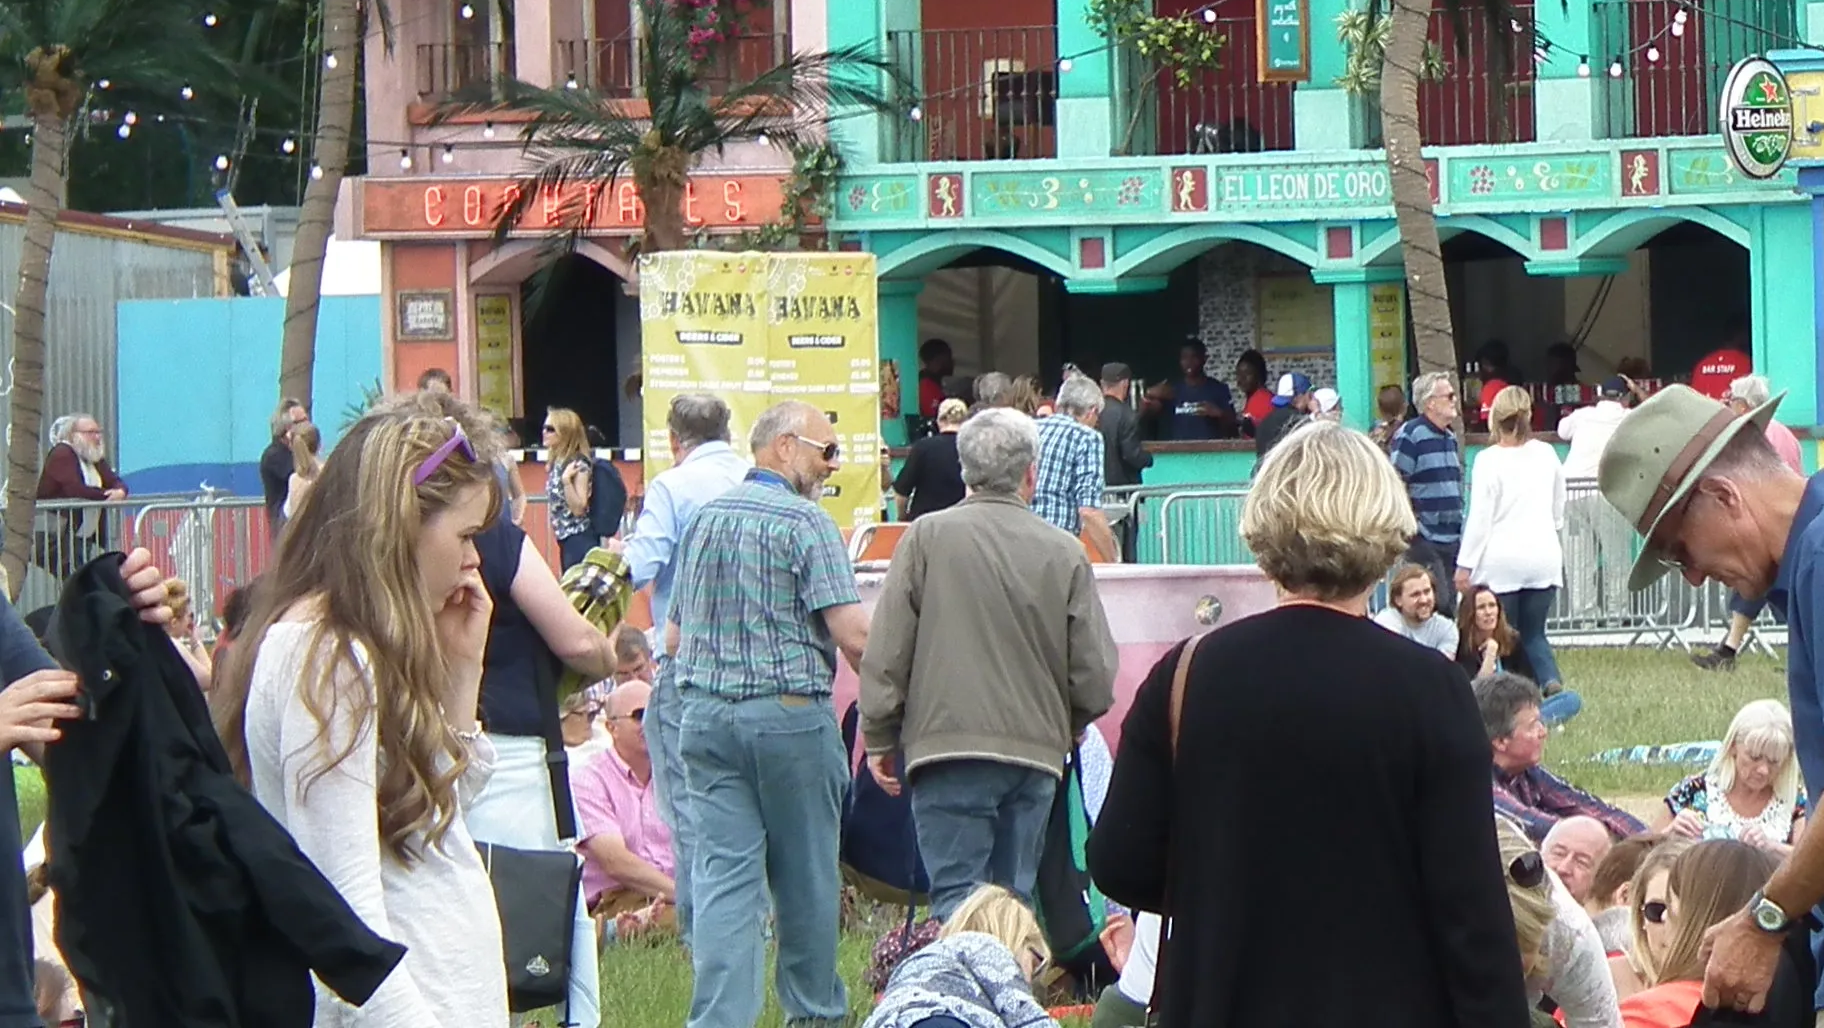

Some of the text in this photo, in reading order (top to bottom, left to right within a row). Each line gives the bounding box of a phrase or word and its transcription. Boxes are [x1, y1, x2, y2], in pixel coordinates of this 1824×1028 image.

[1224, 170, 1388, 201] EL LEON DE ORO
[424, 178, 748, 226] COCKTALS
[661, 290, 756, 319] HAVANA
[774, 294, 861, 322] HAVANA
[716, 333, 740, 343] CIDER
